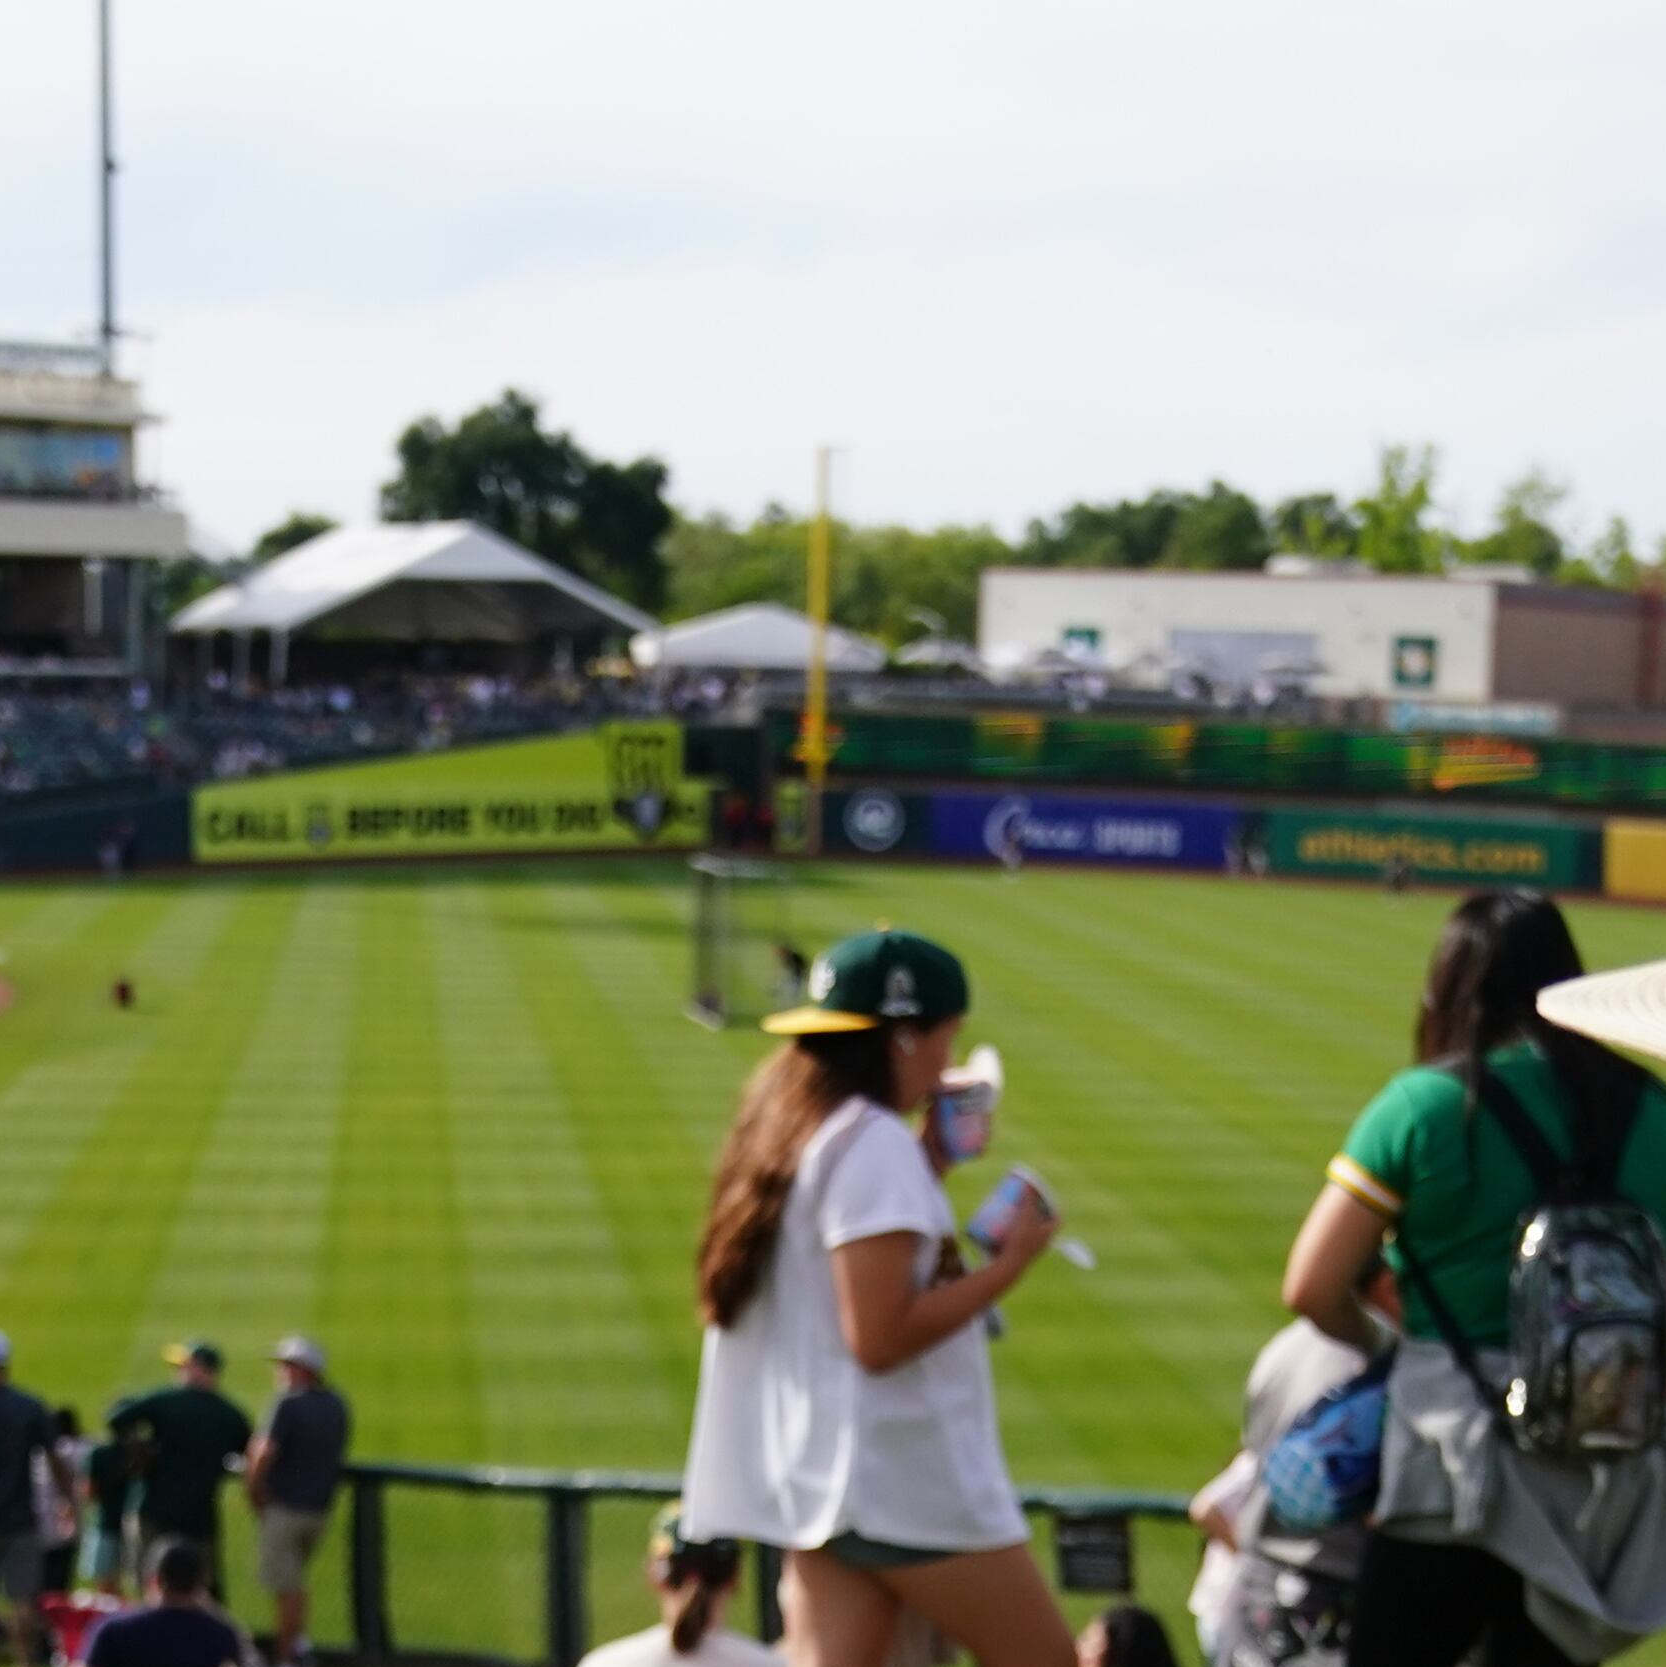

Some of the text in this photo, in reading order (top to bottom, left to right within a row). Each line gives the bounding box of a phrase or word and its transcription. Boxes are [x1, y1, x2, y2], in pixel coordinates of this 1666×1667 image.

[207, 808, 289, 843] CALL
[346, 804, 472, 838] BEFORE
[484, 803, 539, 834] YOU
[1300, 828, 1547, 876] athletics.com
